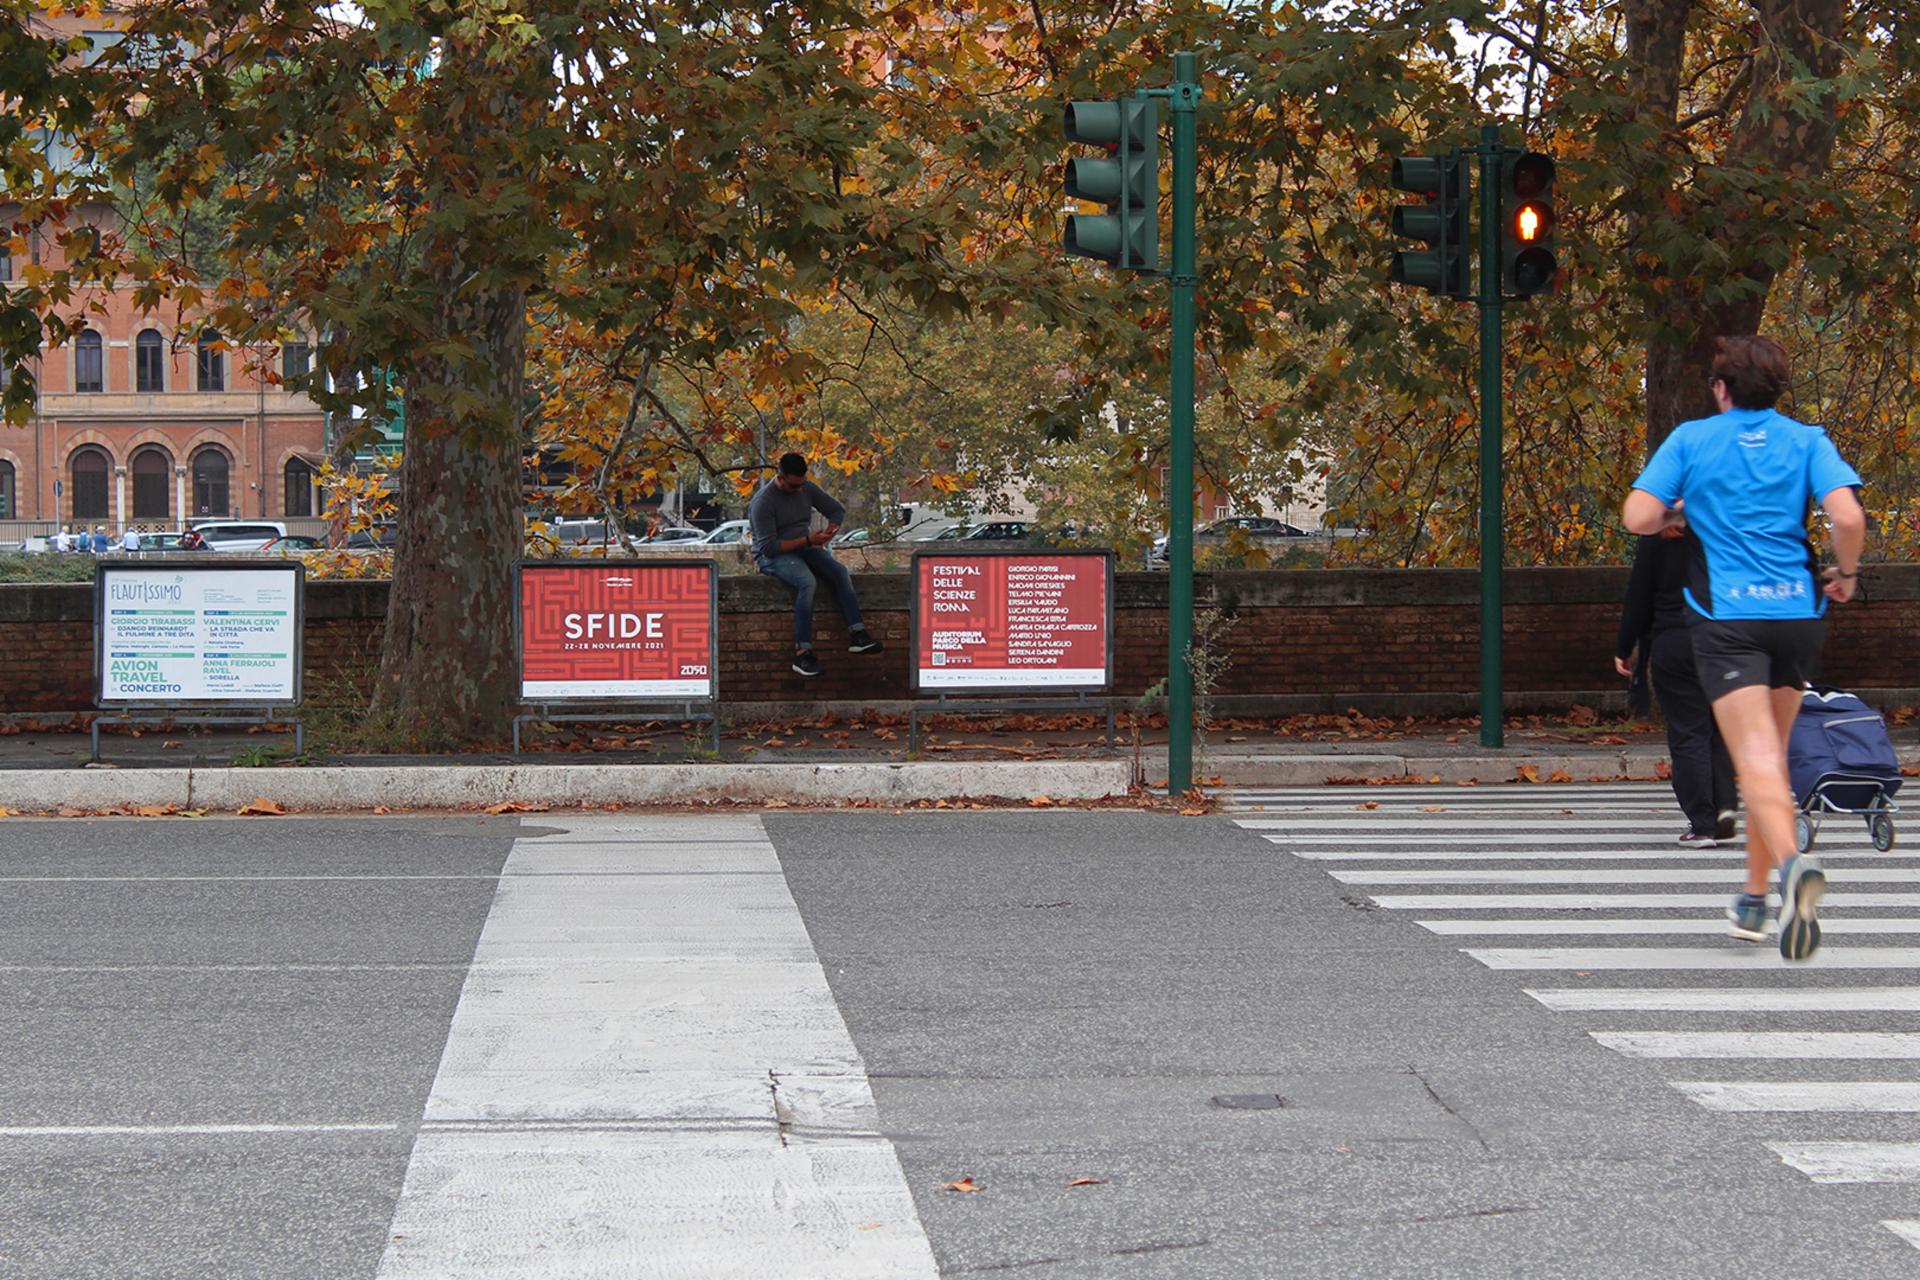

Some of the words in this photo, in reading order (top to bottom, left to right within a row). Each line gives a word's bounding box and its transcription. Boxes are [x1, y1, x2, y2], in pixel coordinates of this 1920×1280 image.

[933, 566, 981, 575] FESTIVAL
[933, 578, 963, 587] DELLE
[111, 581, 181, 603] FLAUTISSIMO
[933, 590, 976, 600] SCIENZE
[933, 603, 970, 612] ROMA
[111, 617, 148, 625] GIORGIO
[151, 617, 195, 625] TIRABASSI
[564, 613, 664, 639] SFIDE
[111, 660, 158, 671] AVION
[110, 672, 167, 682] TRAVEL
[120, 684, 181, 692] CONCERTO
